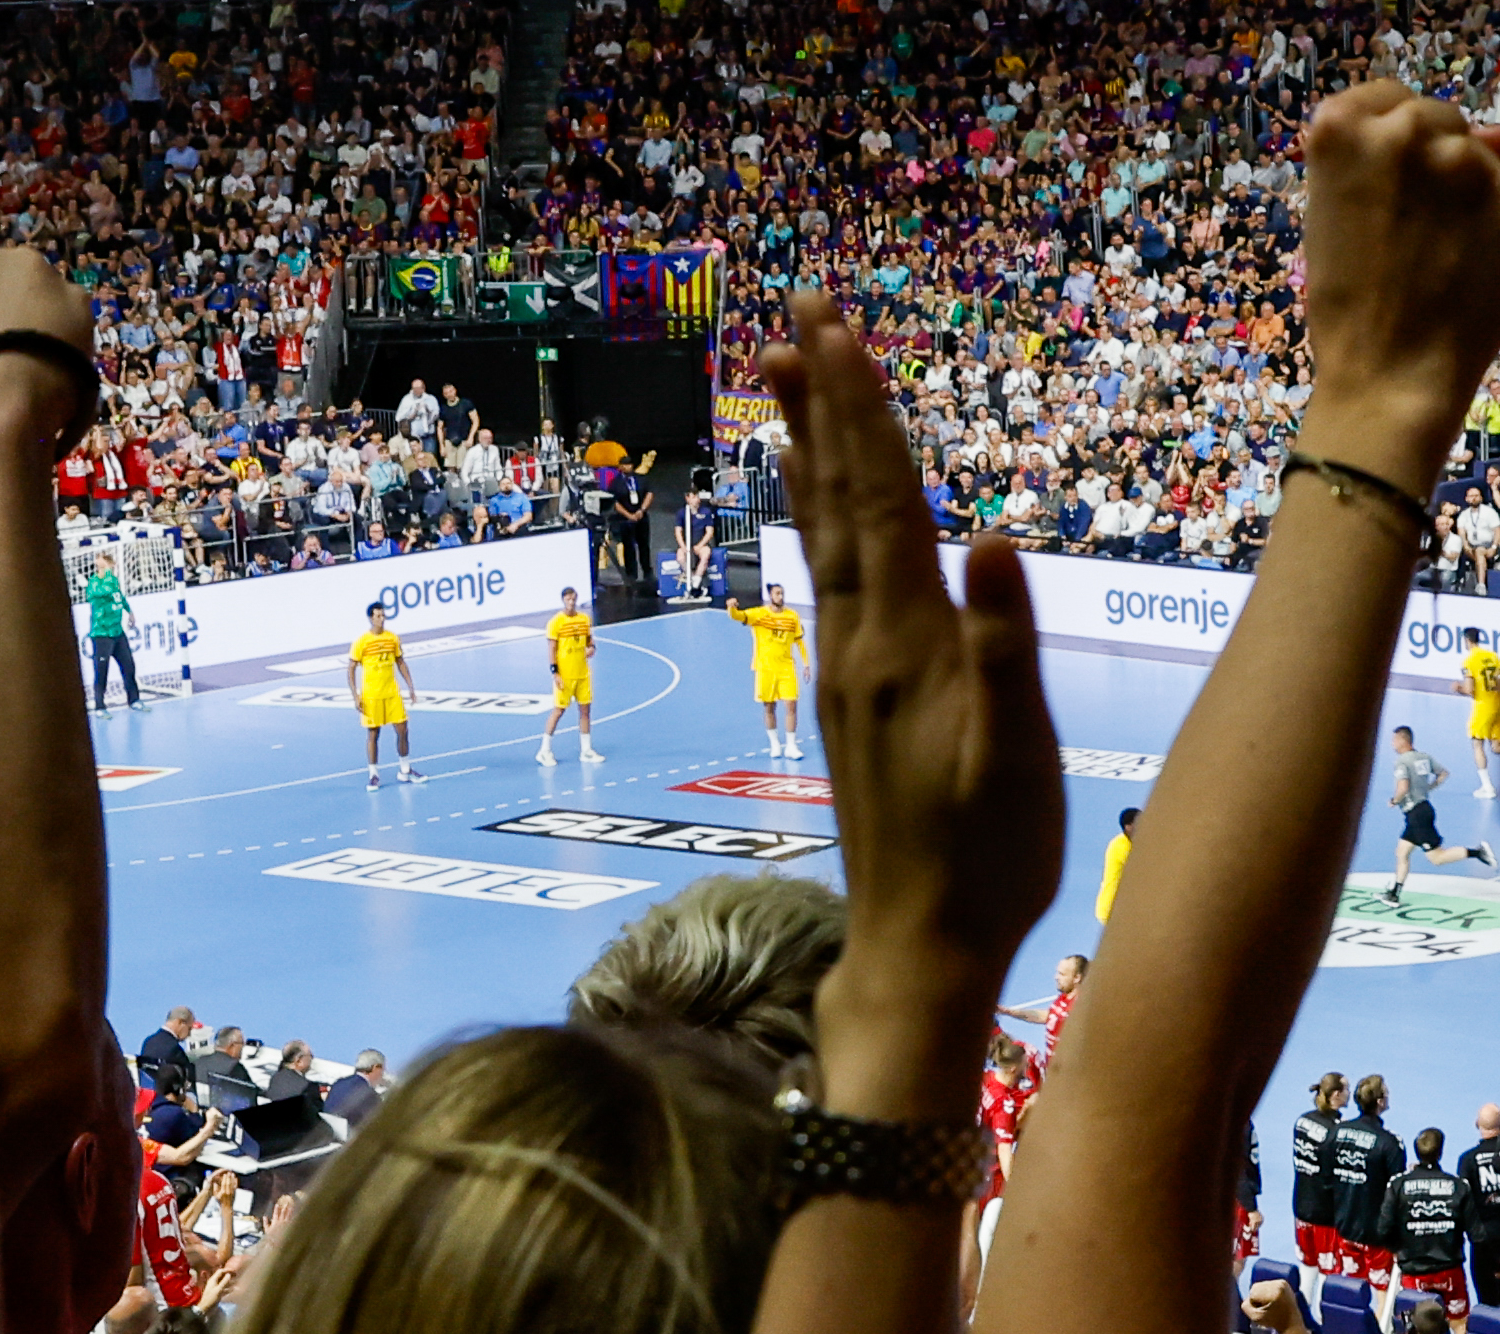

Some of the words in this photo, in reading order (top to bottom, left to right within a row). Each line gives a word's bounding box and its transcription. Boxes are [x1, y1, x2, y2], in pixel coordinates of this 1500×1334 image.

[380, 562, 506, 620] gorenje
[1105, 588, 1230, 633] gorenje
[497, 811, 837, 858] SELECT
[292, 853, 625, 903] HEITEC
